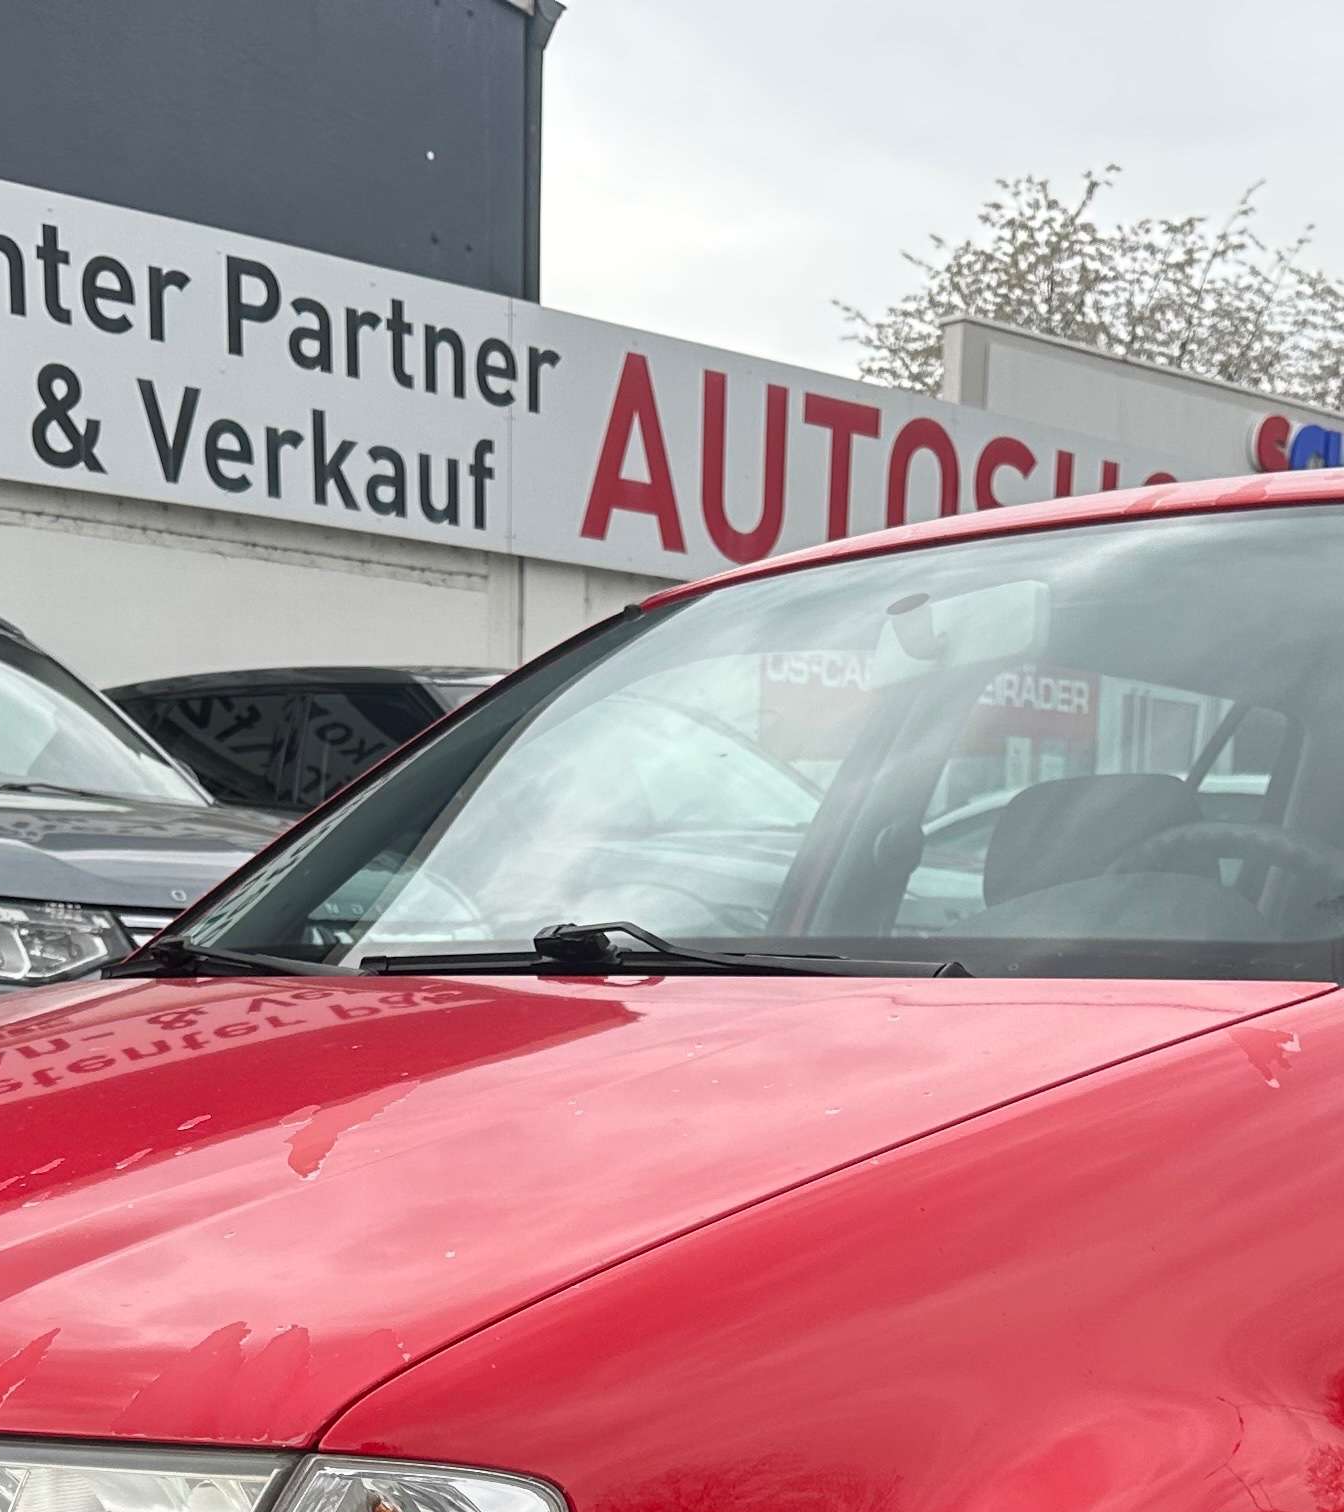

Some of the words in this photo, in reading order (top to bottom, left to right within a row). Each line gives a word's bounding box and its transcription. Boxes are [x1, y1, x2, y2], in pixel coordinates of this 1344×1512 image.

[224, 254, 561, 414] Partner
[31, 362, 108, 475] &
[137, 377, 496, 531] Verkauf
